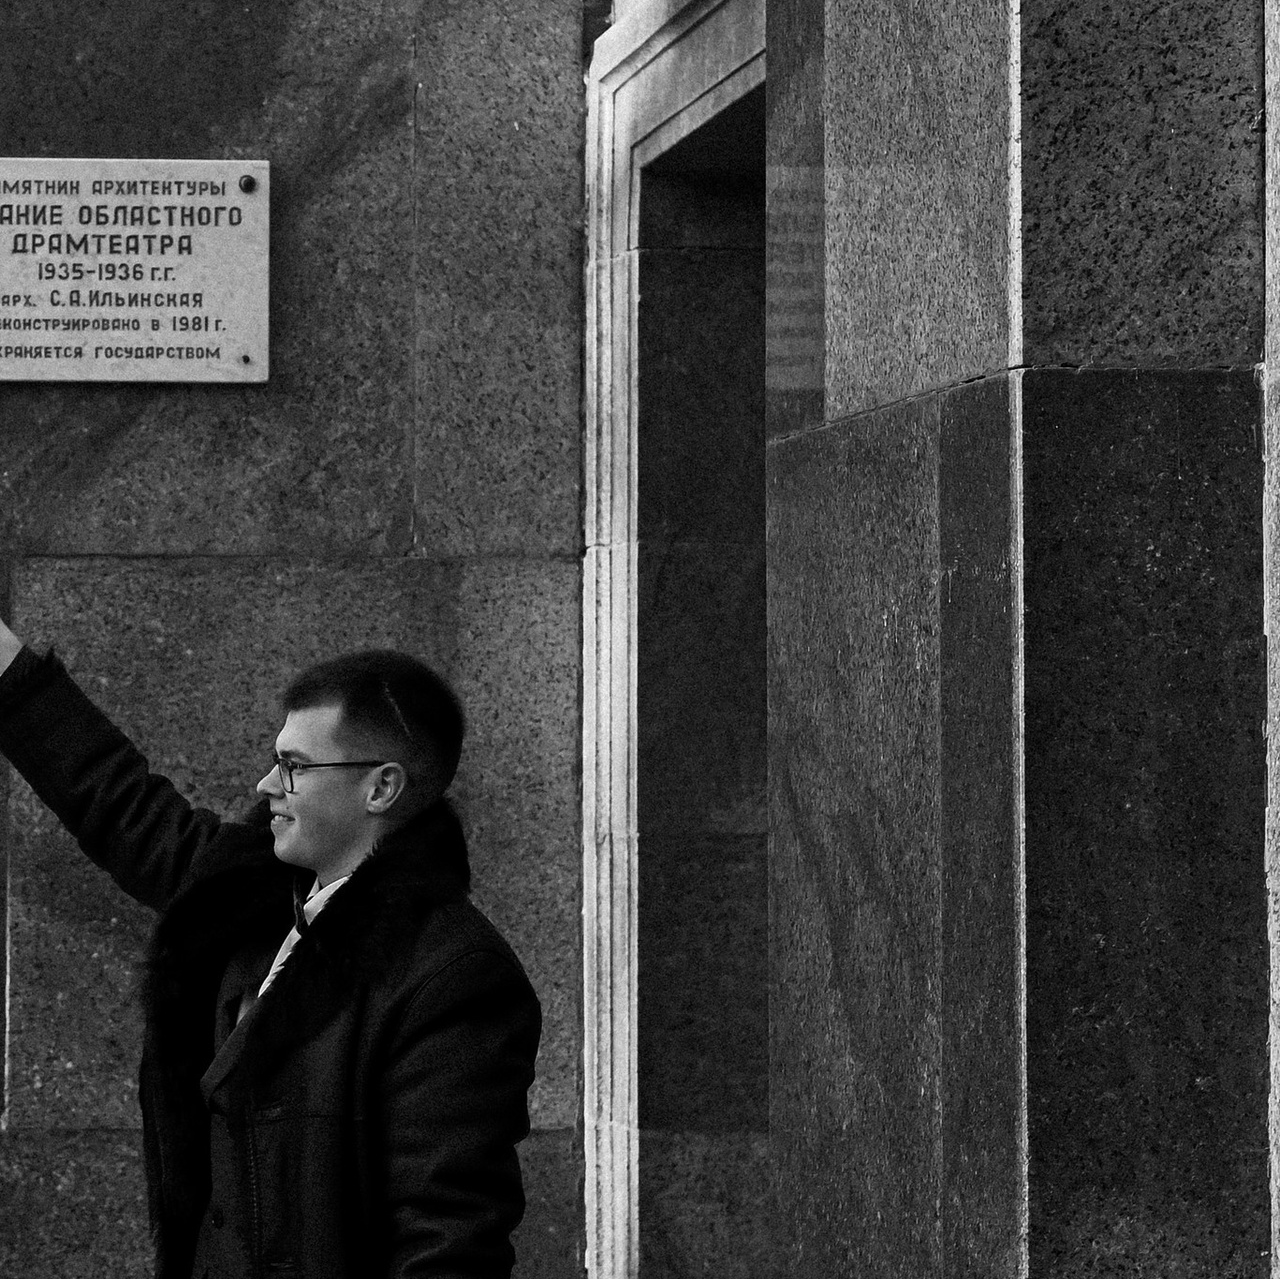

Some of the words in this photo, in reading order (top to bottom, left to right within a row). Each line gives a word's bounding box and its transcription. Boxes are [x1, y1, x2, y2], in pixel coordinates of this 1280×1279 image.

[91, 179, 226, 197] АРХИТЕКТУРЫ
[78, 204, 243, 228] ОБЛАСТНОГО
[11, 233, 193, 256] ДРАМТЕАТРА
[38, 262, 144, 282] 1935-1936
[172, 315, 209, 332] 1981
[94, 345, 221, 360] ГОСУДАРСТВОМ
